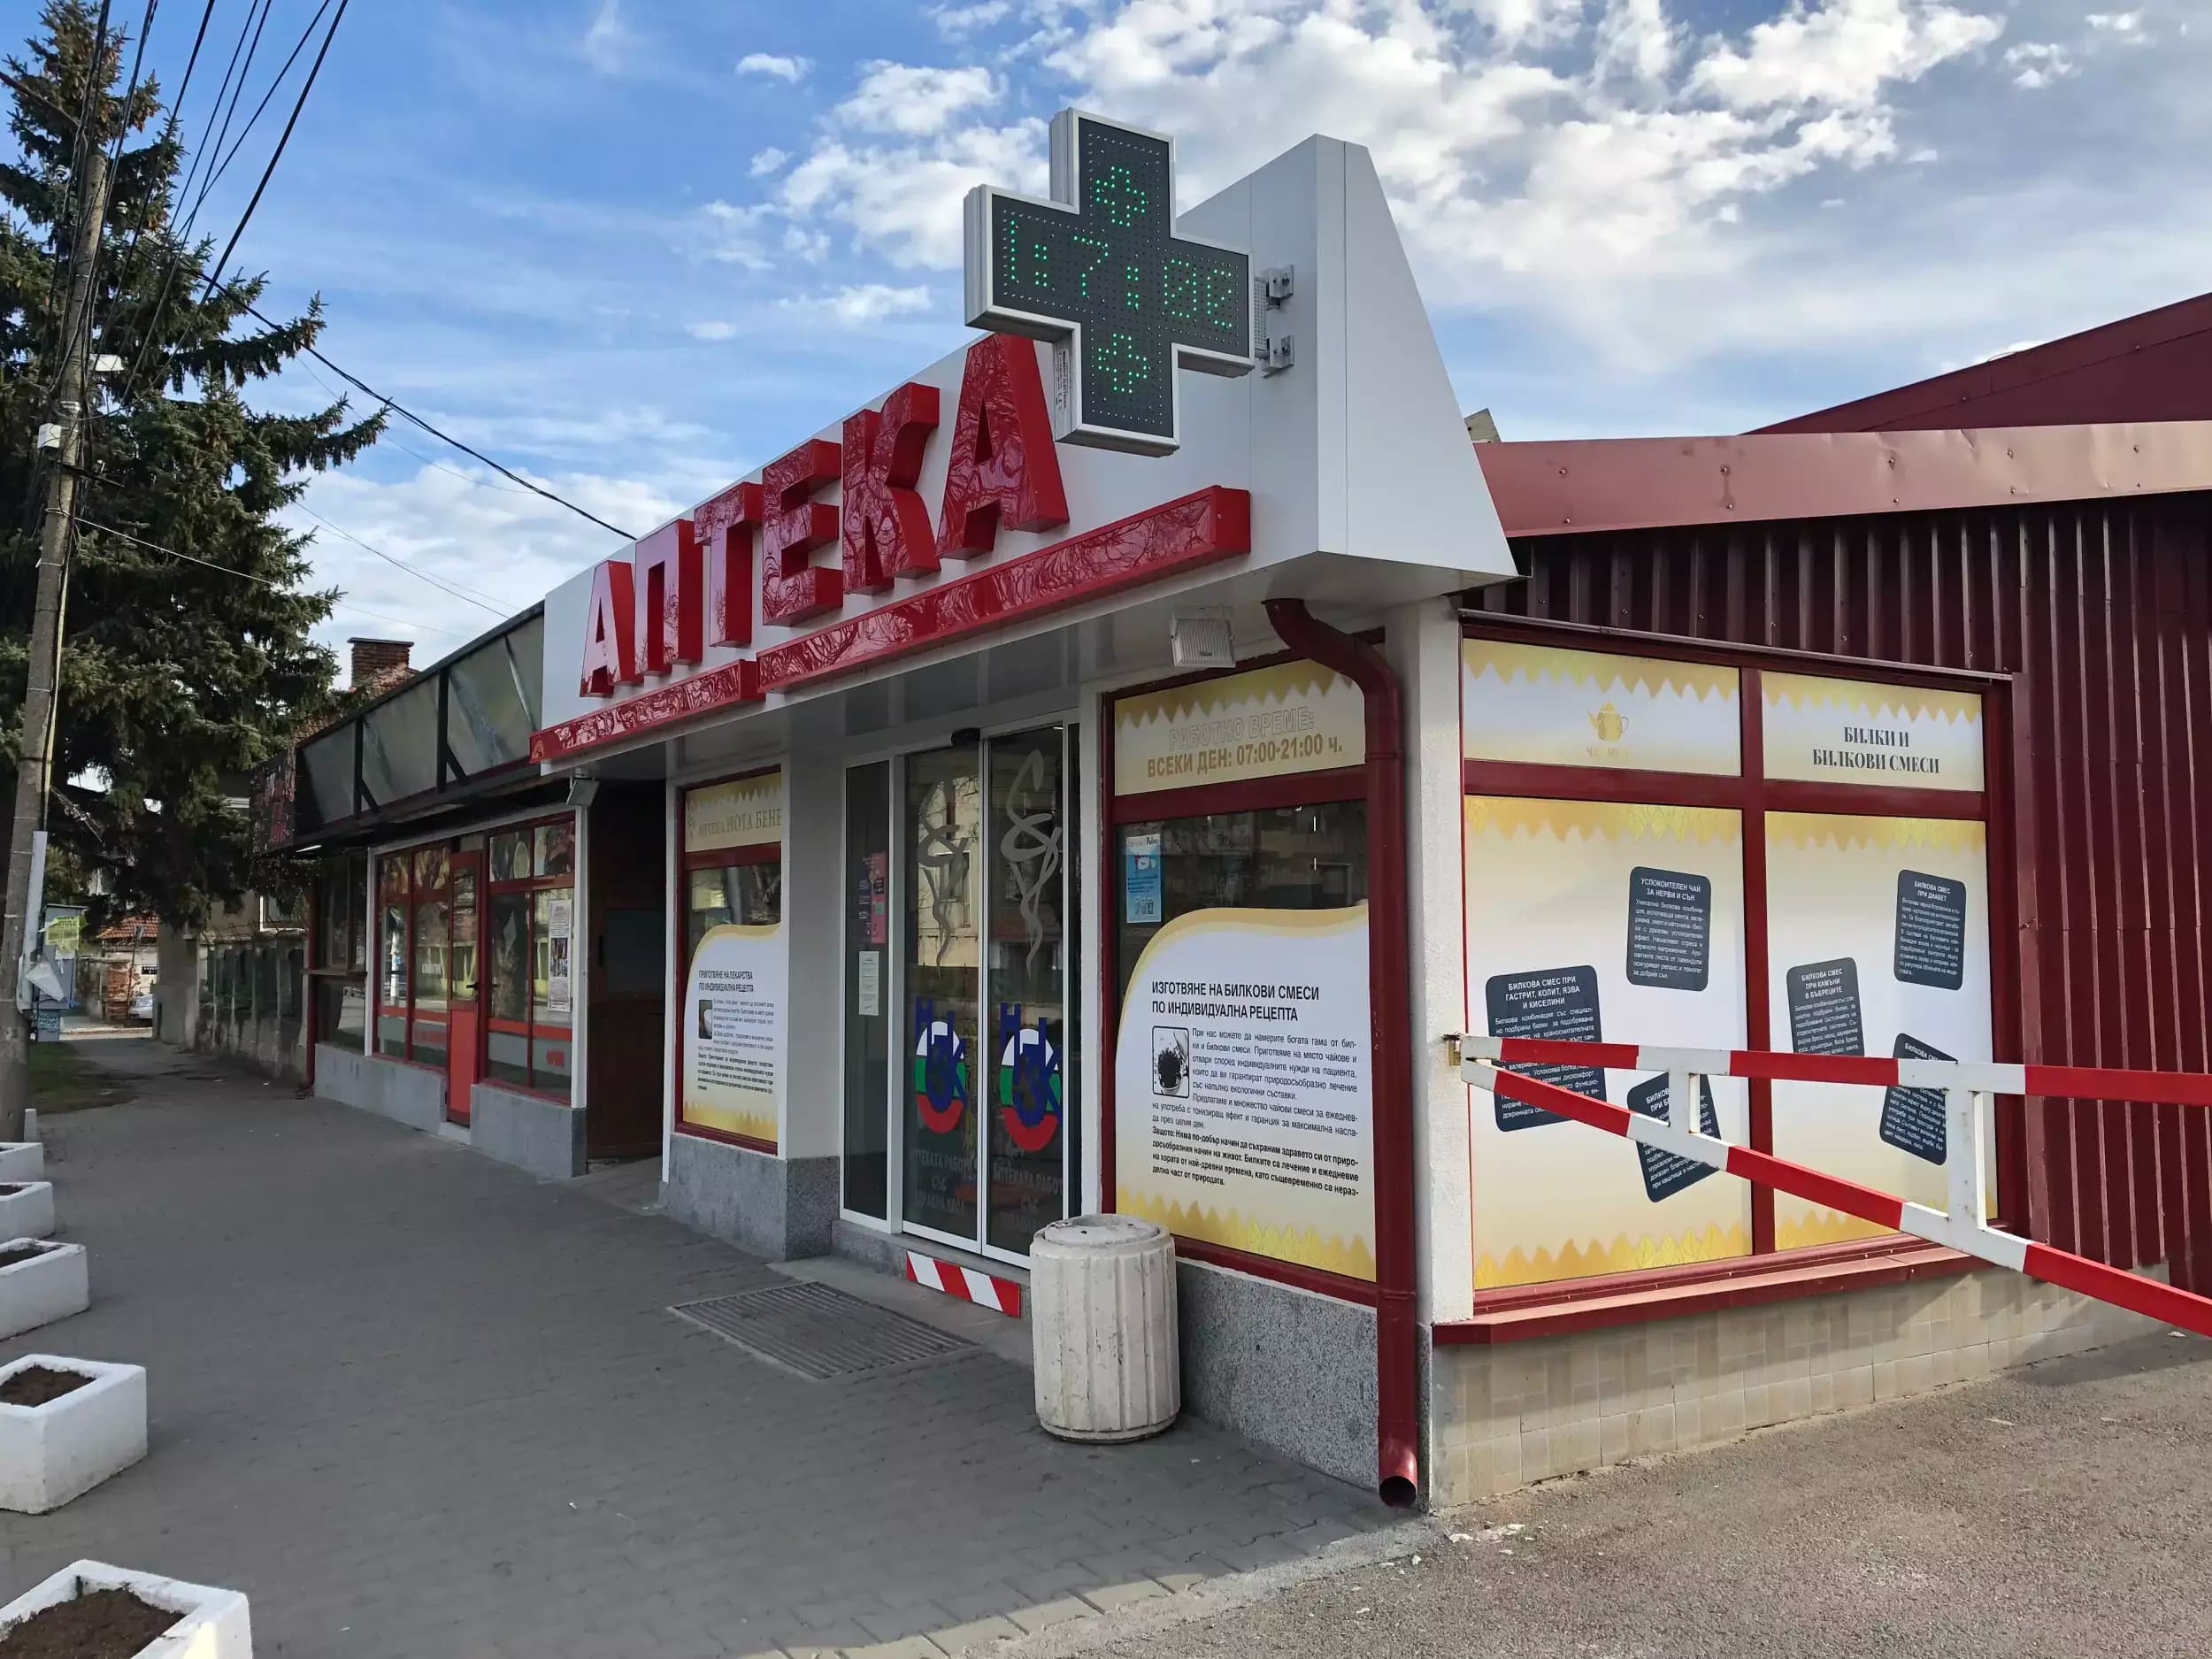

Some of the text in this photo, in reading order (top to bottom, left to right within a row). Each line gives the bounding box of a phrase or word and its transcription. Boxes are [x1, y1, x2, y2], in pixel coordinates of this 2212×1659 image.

[580, 332, 1070, 697] АПТЕКА
[1170, 706, 1315, 750] РАБОТНО ВРЕМЕ:
[1844, 726, 1909, 748] БИЛКИ И
[1148, 733, 1342, 778] ВСЕКИ ДЕН: 07:00-21:00 ч.
[1813, 749, 1939, 773] БИЛКОВИ СМЕСИ
[756, 808, 782, 829] БЕНЕ
[1640, 878, 1701, 893] УСПОКОИТЕЛЕН ЧАЙ
[1655, 889, 1676, 898] НЕРВИ
[1508, 980, 1540, 991] БИЛКОВА
[1541, 977, 1561, 988] СМЕС
[1801, 968, 1843, 981] БИЛКОВА СМЕС
[1152, 981, 1319, 1000] ИЗГОТВЯНЕ НА БИЛКОВИ СМЕСИ
[1505, 985, 1580, 1002] ГАСТРИТ, КОЛИТ, ЯЗВА
[1152, 1001, 1298, 1022] ПО ИНДИВИДУАЛНА РЕЦЕПТА
[1529, 997, 1565, 1009] КИСЕЛИНИ
[1646, 1087, 1670, 1104] БИЛКОВ
